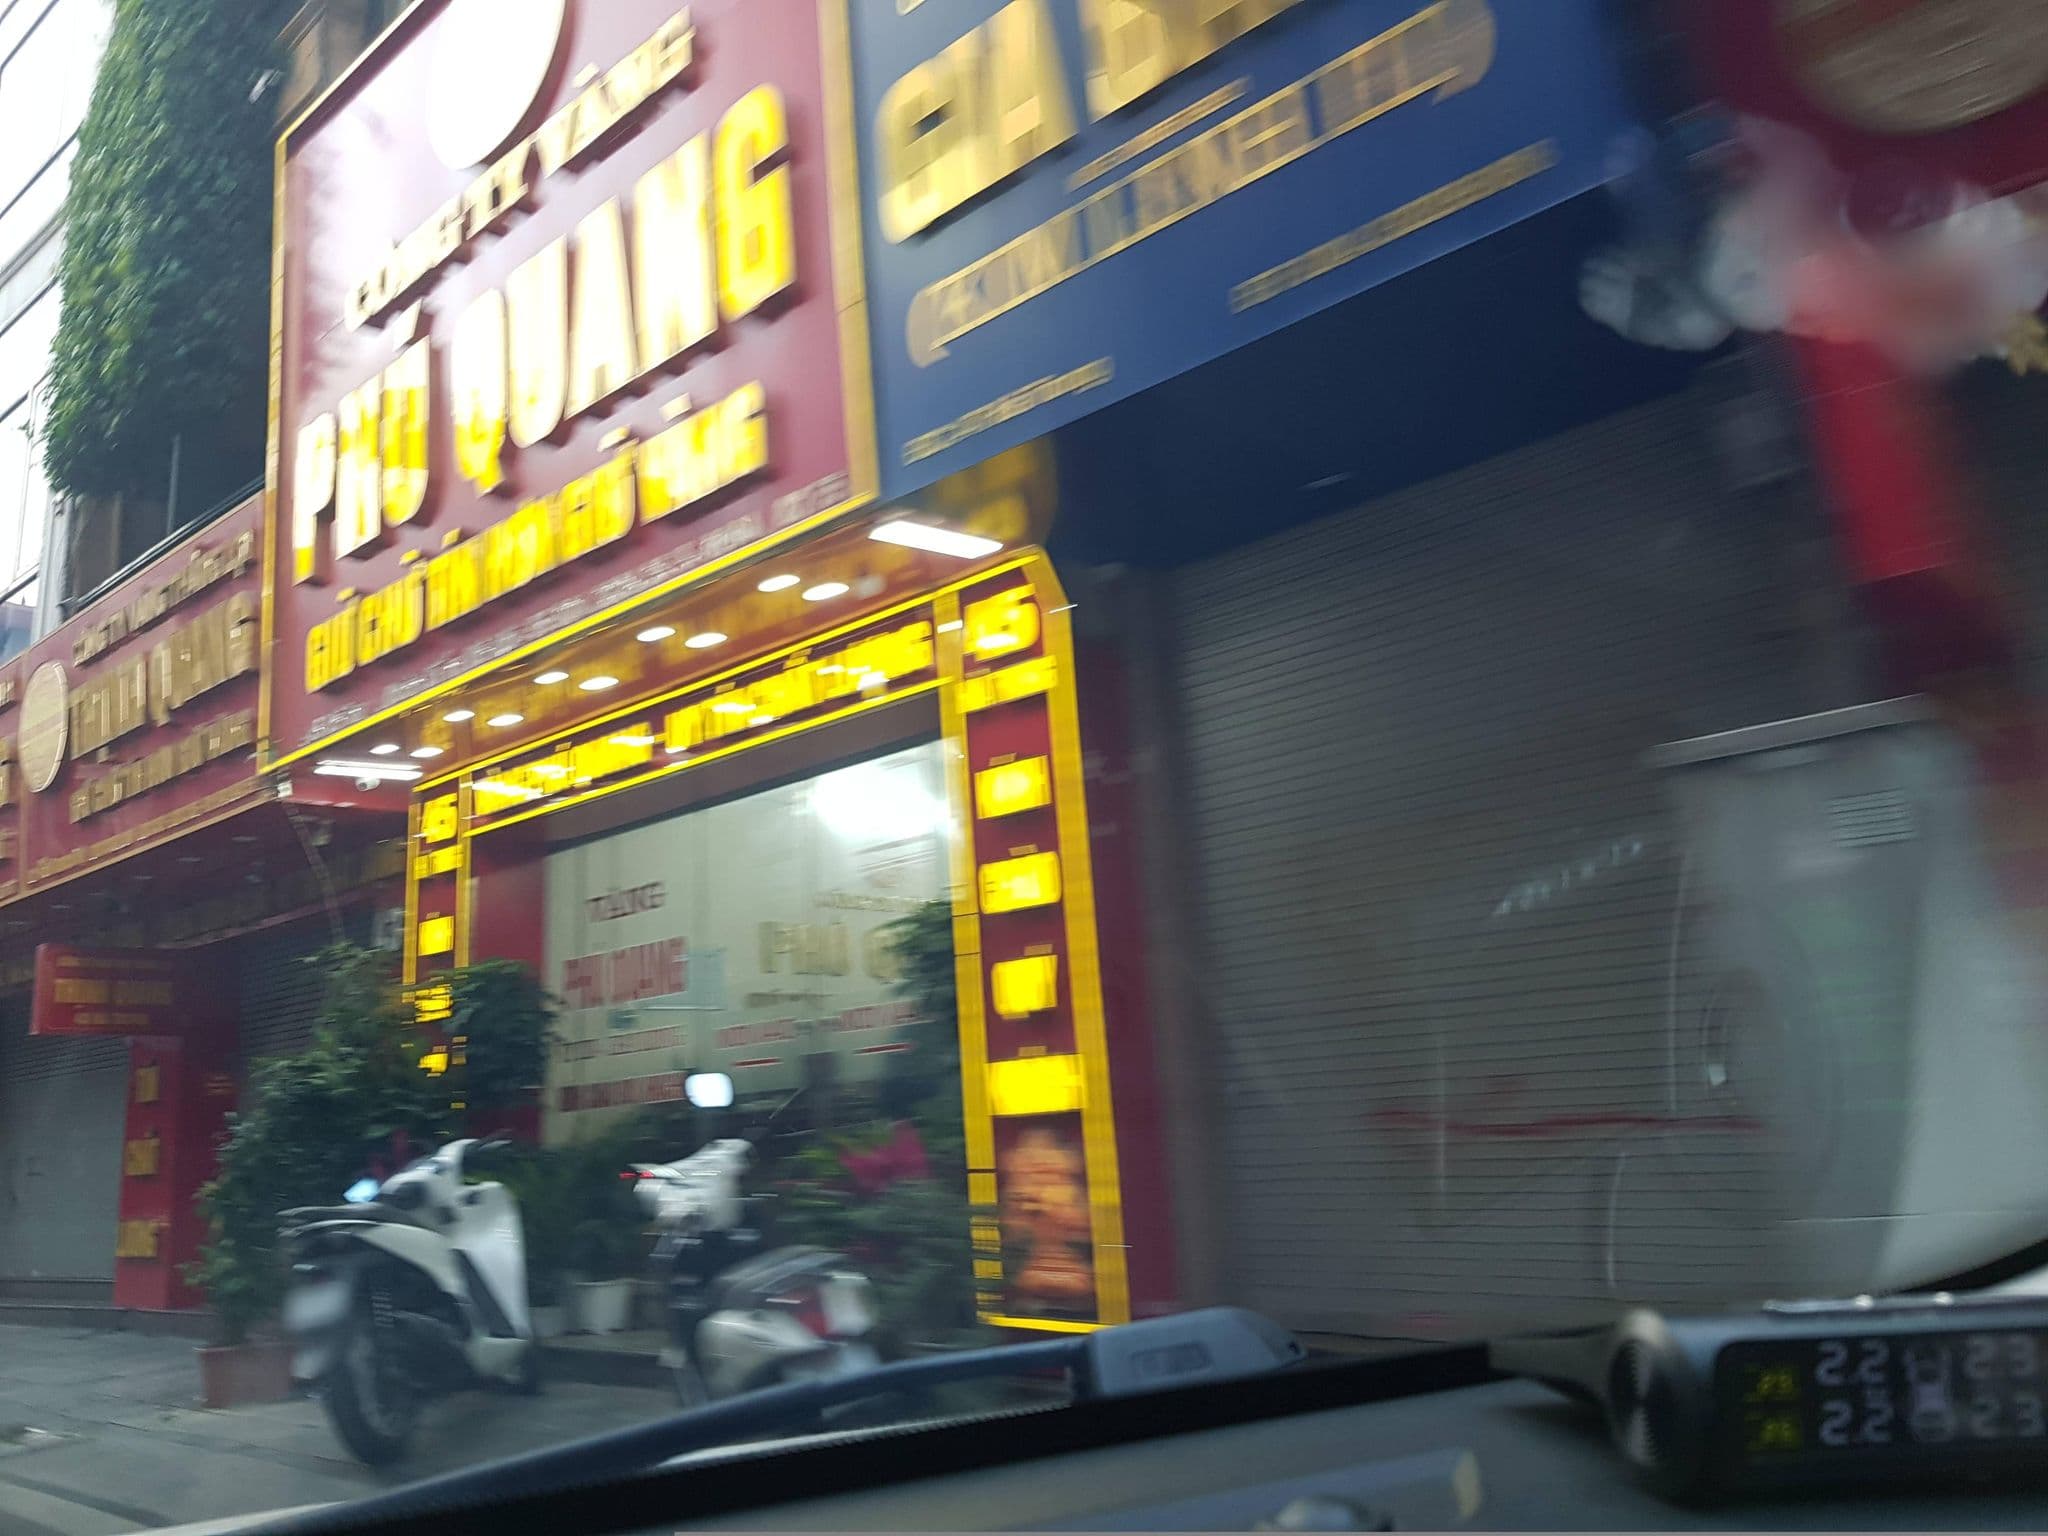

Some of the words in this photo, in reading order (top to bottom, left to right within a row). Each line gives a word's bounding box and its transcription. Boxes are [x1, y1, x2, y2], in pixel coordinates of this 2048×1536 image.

[537, 4, 697, 180] VÀNG
[292, 298, 430, 587] PHÚ
[450, 83, 797, 497] QUANG
